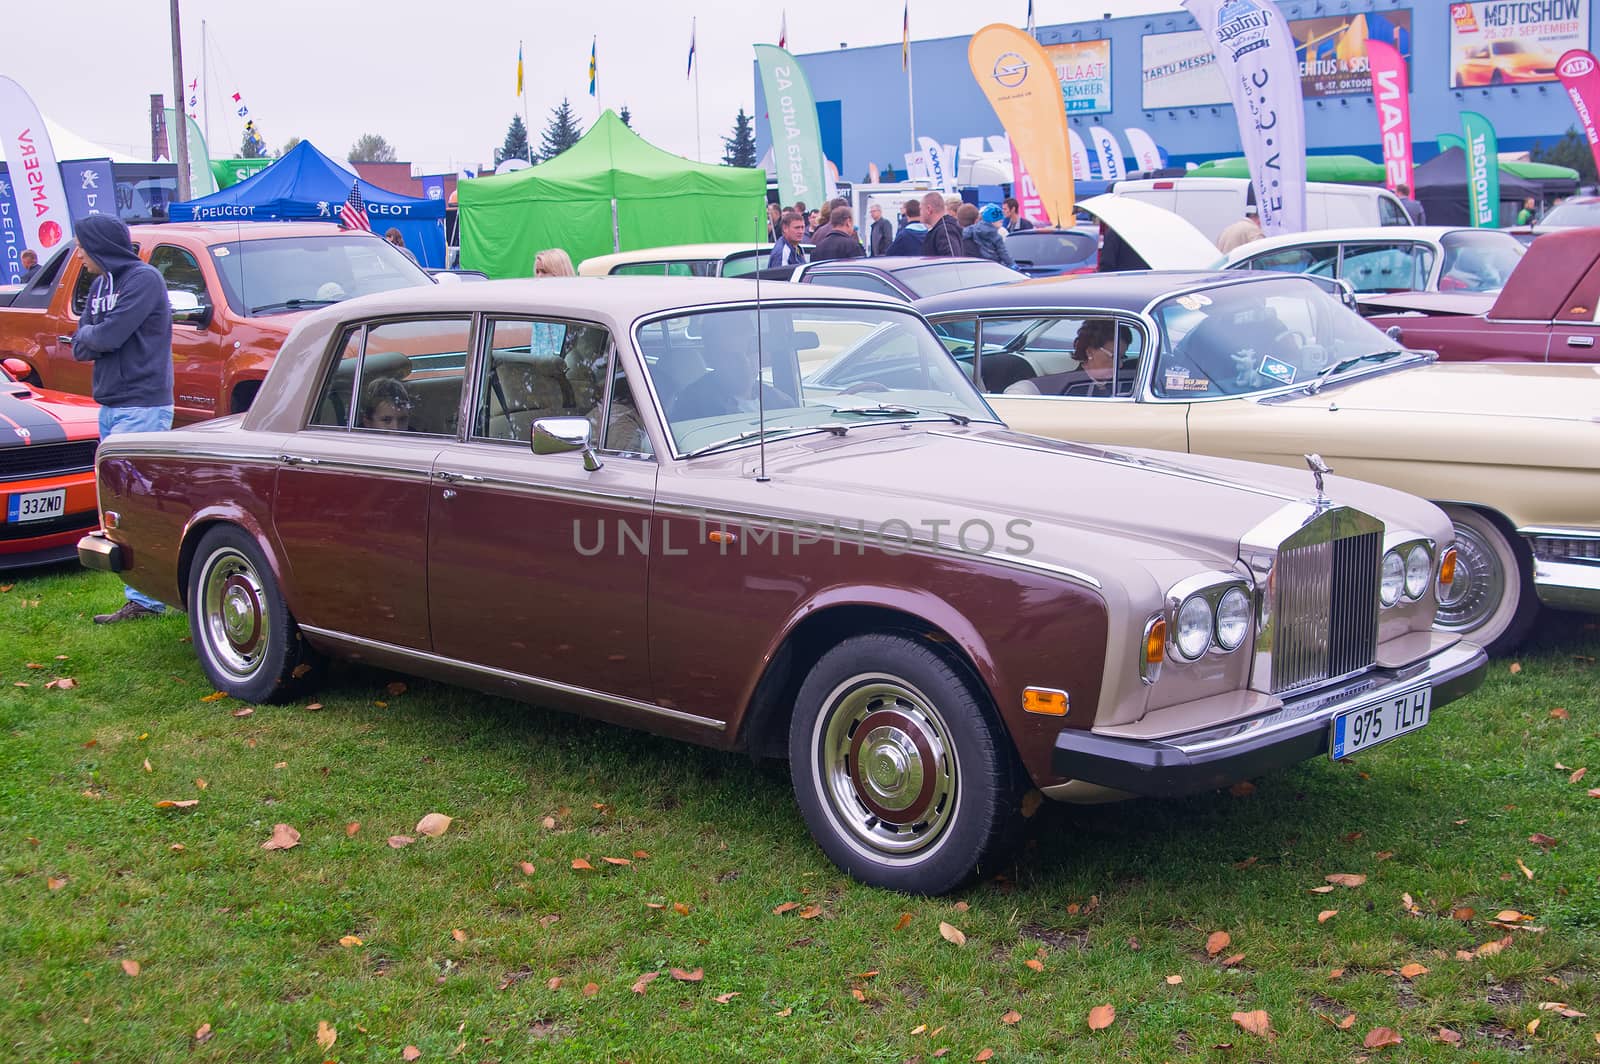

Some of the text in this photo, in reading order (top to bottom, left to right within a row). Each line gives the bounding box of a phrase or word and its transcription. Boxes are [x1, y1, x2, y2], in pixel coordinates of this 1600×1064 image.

[1453, 6, 1467, 19] 20
[1484, 0, 1580, 27] MOTOSHOW
[1520, 21, 1579, 36] SEPTEMBER
[1144, 63, 1176, 80] TARTU
[202, 206, 256, 218] PEUGEOT
[334, 203, 412, 216] PGEOT
[23, 495, 62, 515] 33ZND
[1353, 691, 1426, 746] 975 TLH
